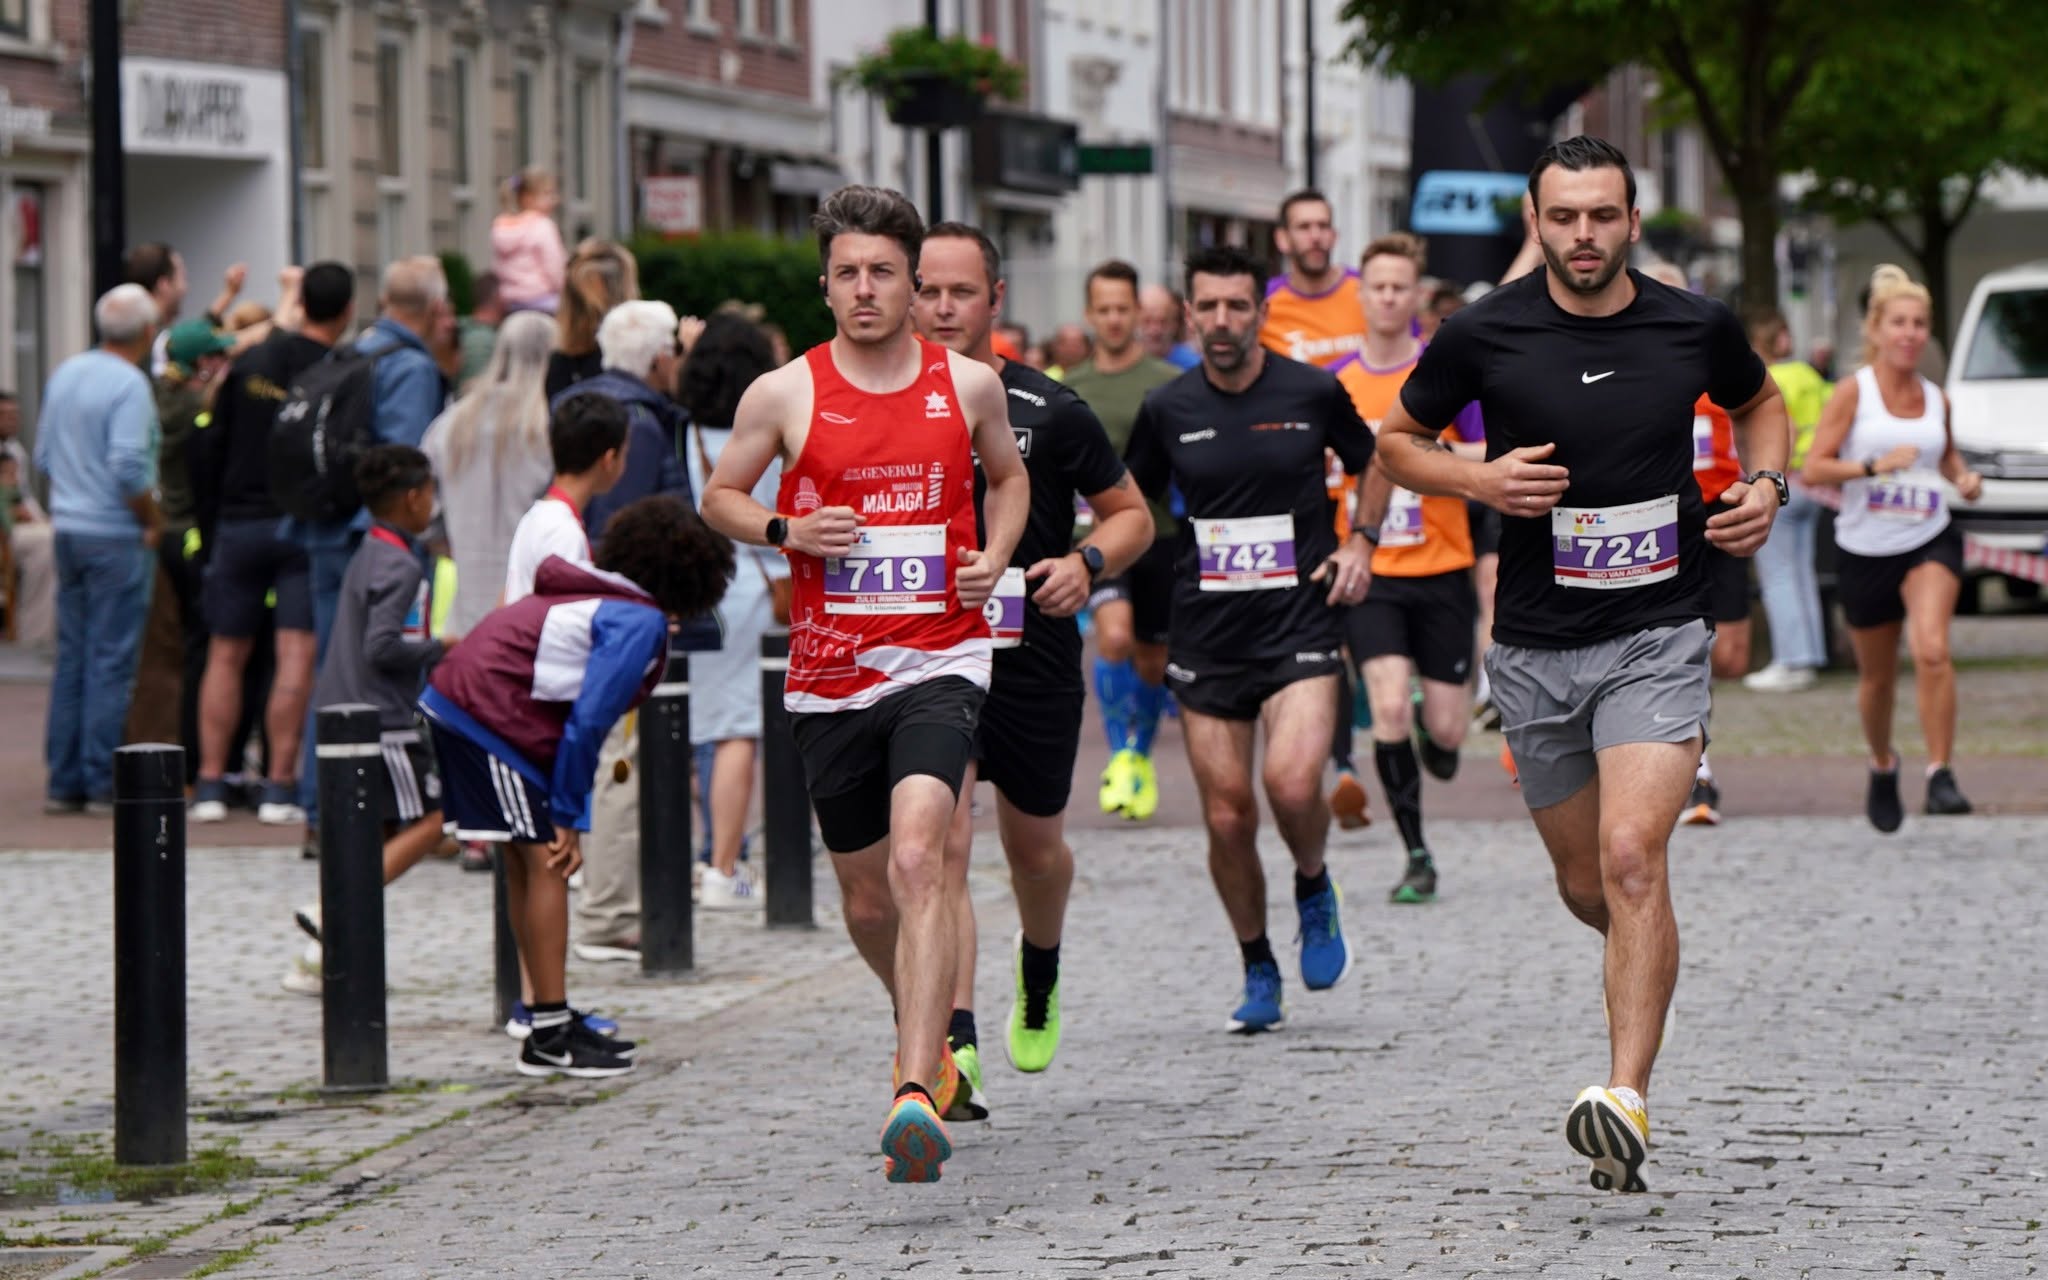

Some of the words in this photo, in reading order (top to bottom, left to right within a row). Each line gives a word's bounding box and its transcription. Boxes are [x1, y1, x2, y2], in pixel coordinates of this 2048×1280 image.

[861, 463, 923, 479] GENERALI
[862, 489, 924, 513] MÁLAGA
[1211, 543, 1278, 571] 742
[1577, 530, 1660, 568] 724
[844, 557, 927, 592] 719
[1587, 570, 1608, 579] NINO
[1609, 569, 1626, 578] VAN
[1626, 566, 1653, 577] ARKEL
